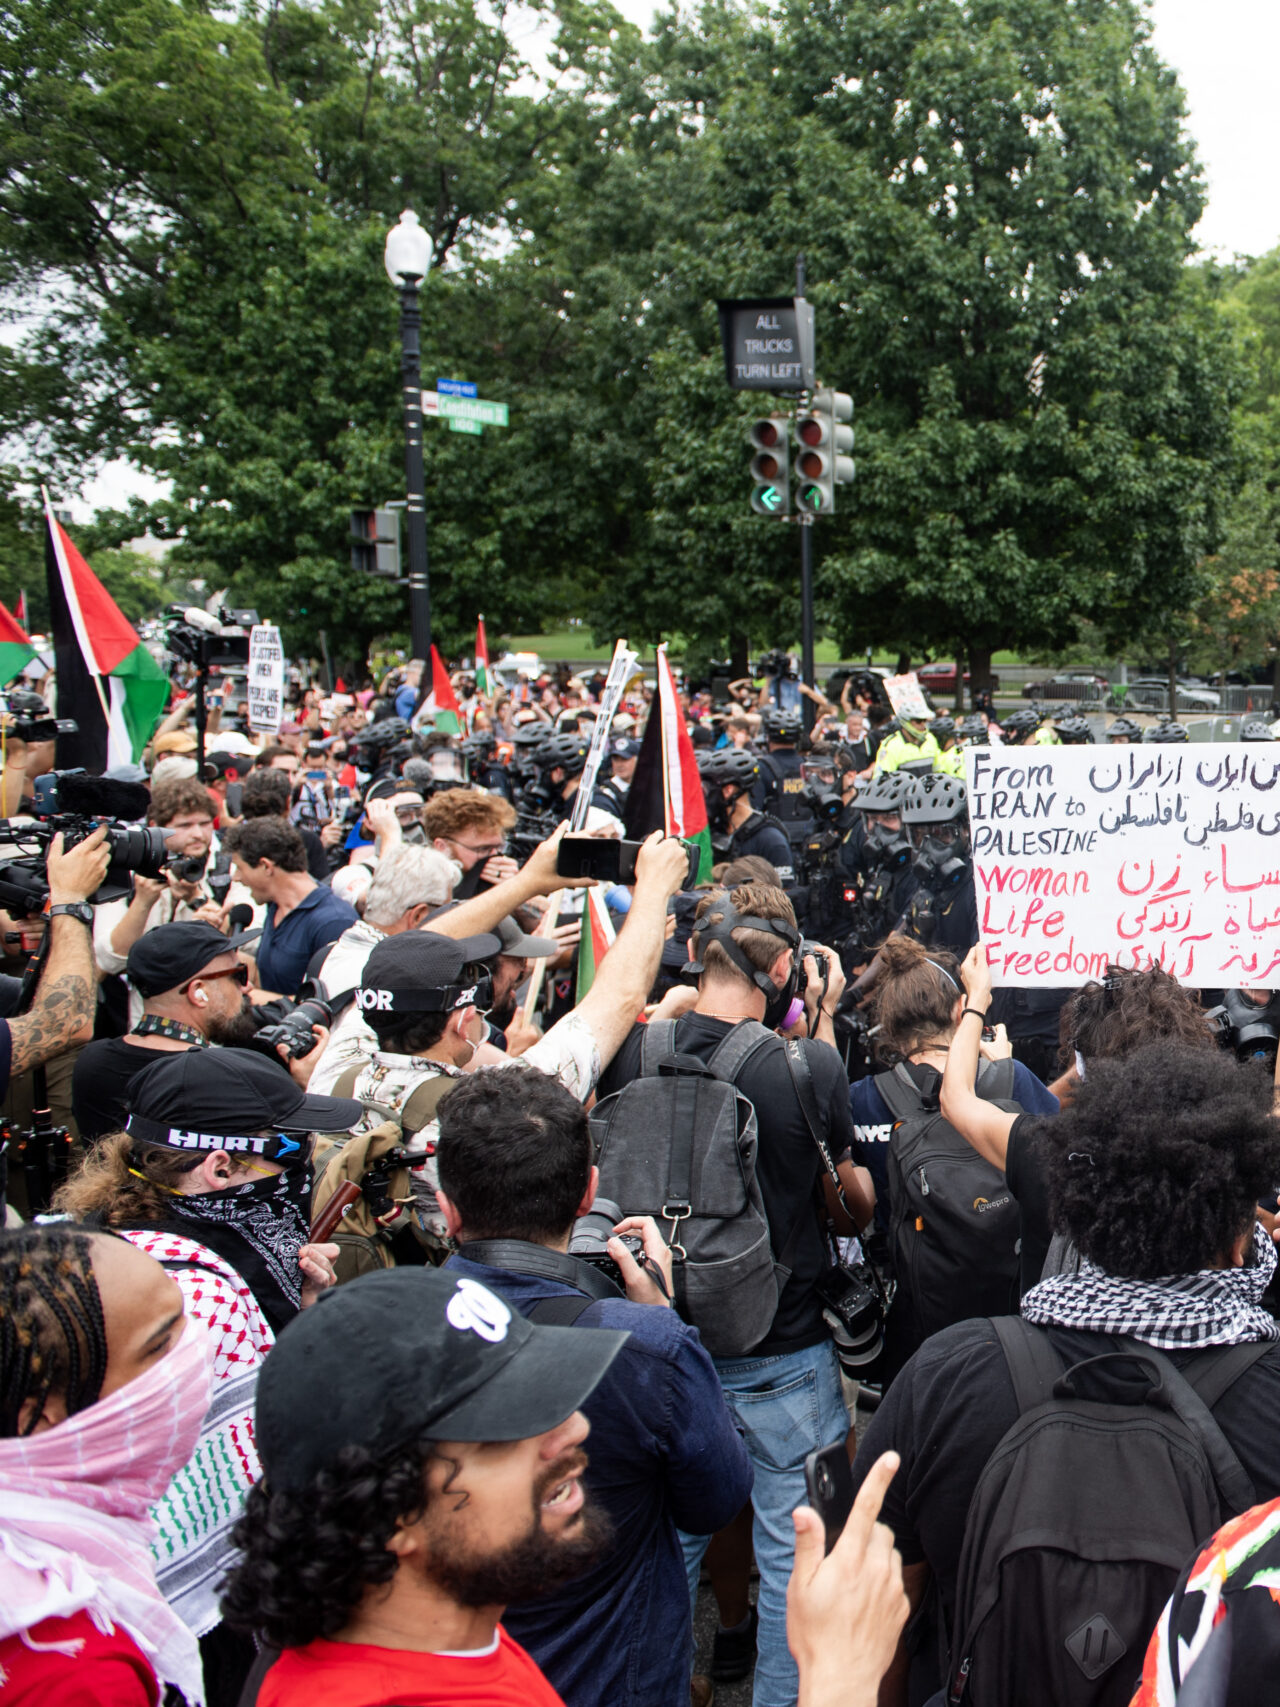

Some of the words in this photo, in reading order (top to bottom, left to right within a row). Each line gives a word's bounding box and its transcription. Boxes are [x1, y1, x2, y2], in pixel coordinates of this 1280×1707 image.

[756, 314, 781, 330] ALL
[744, 338, 793, 354] TRUCKS
[735, 363, 770, 379] TURN
[772, 362, 801, 378] LEFT
[973, 753, 1054, 789] From
[972, 790, 1057, 820] IRAN
[1065, 795, 1085, 816] to
[973, 825, 1098, 856] PALESTINE
[1117, 854, 1182, 897] زن
[982, 895, 1065, 938] Life
[985, 935, 1109, 978] Freedom
[168, 1128, 270, 1154] HART
[978, 1196, 1010, 1212] Lowepro
